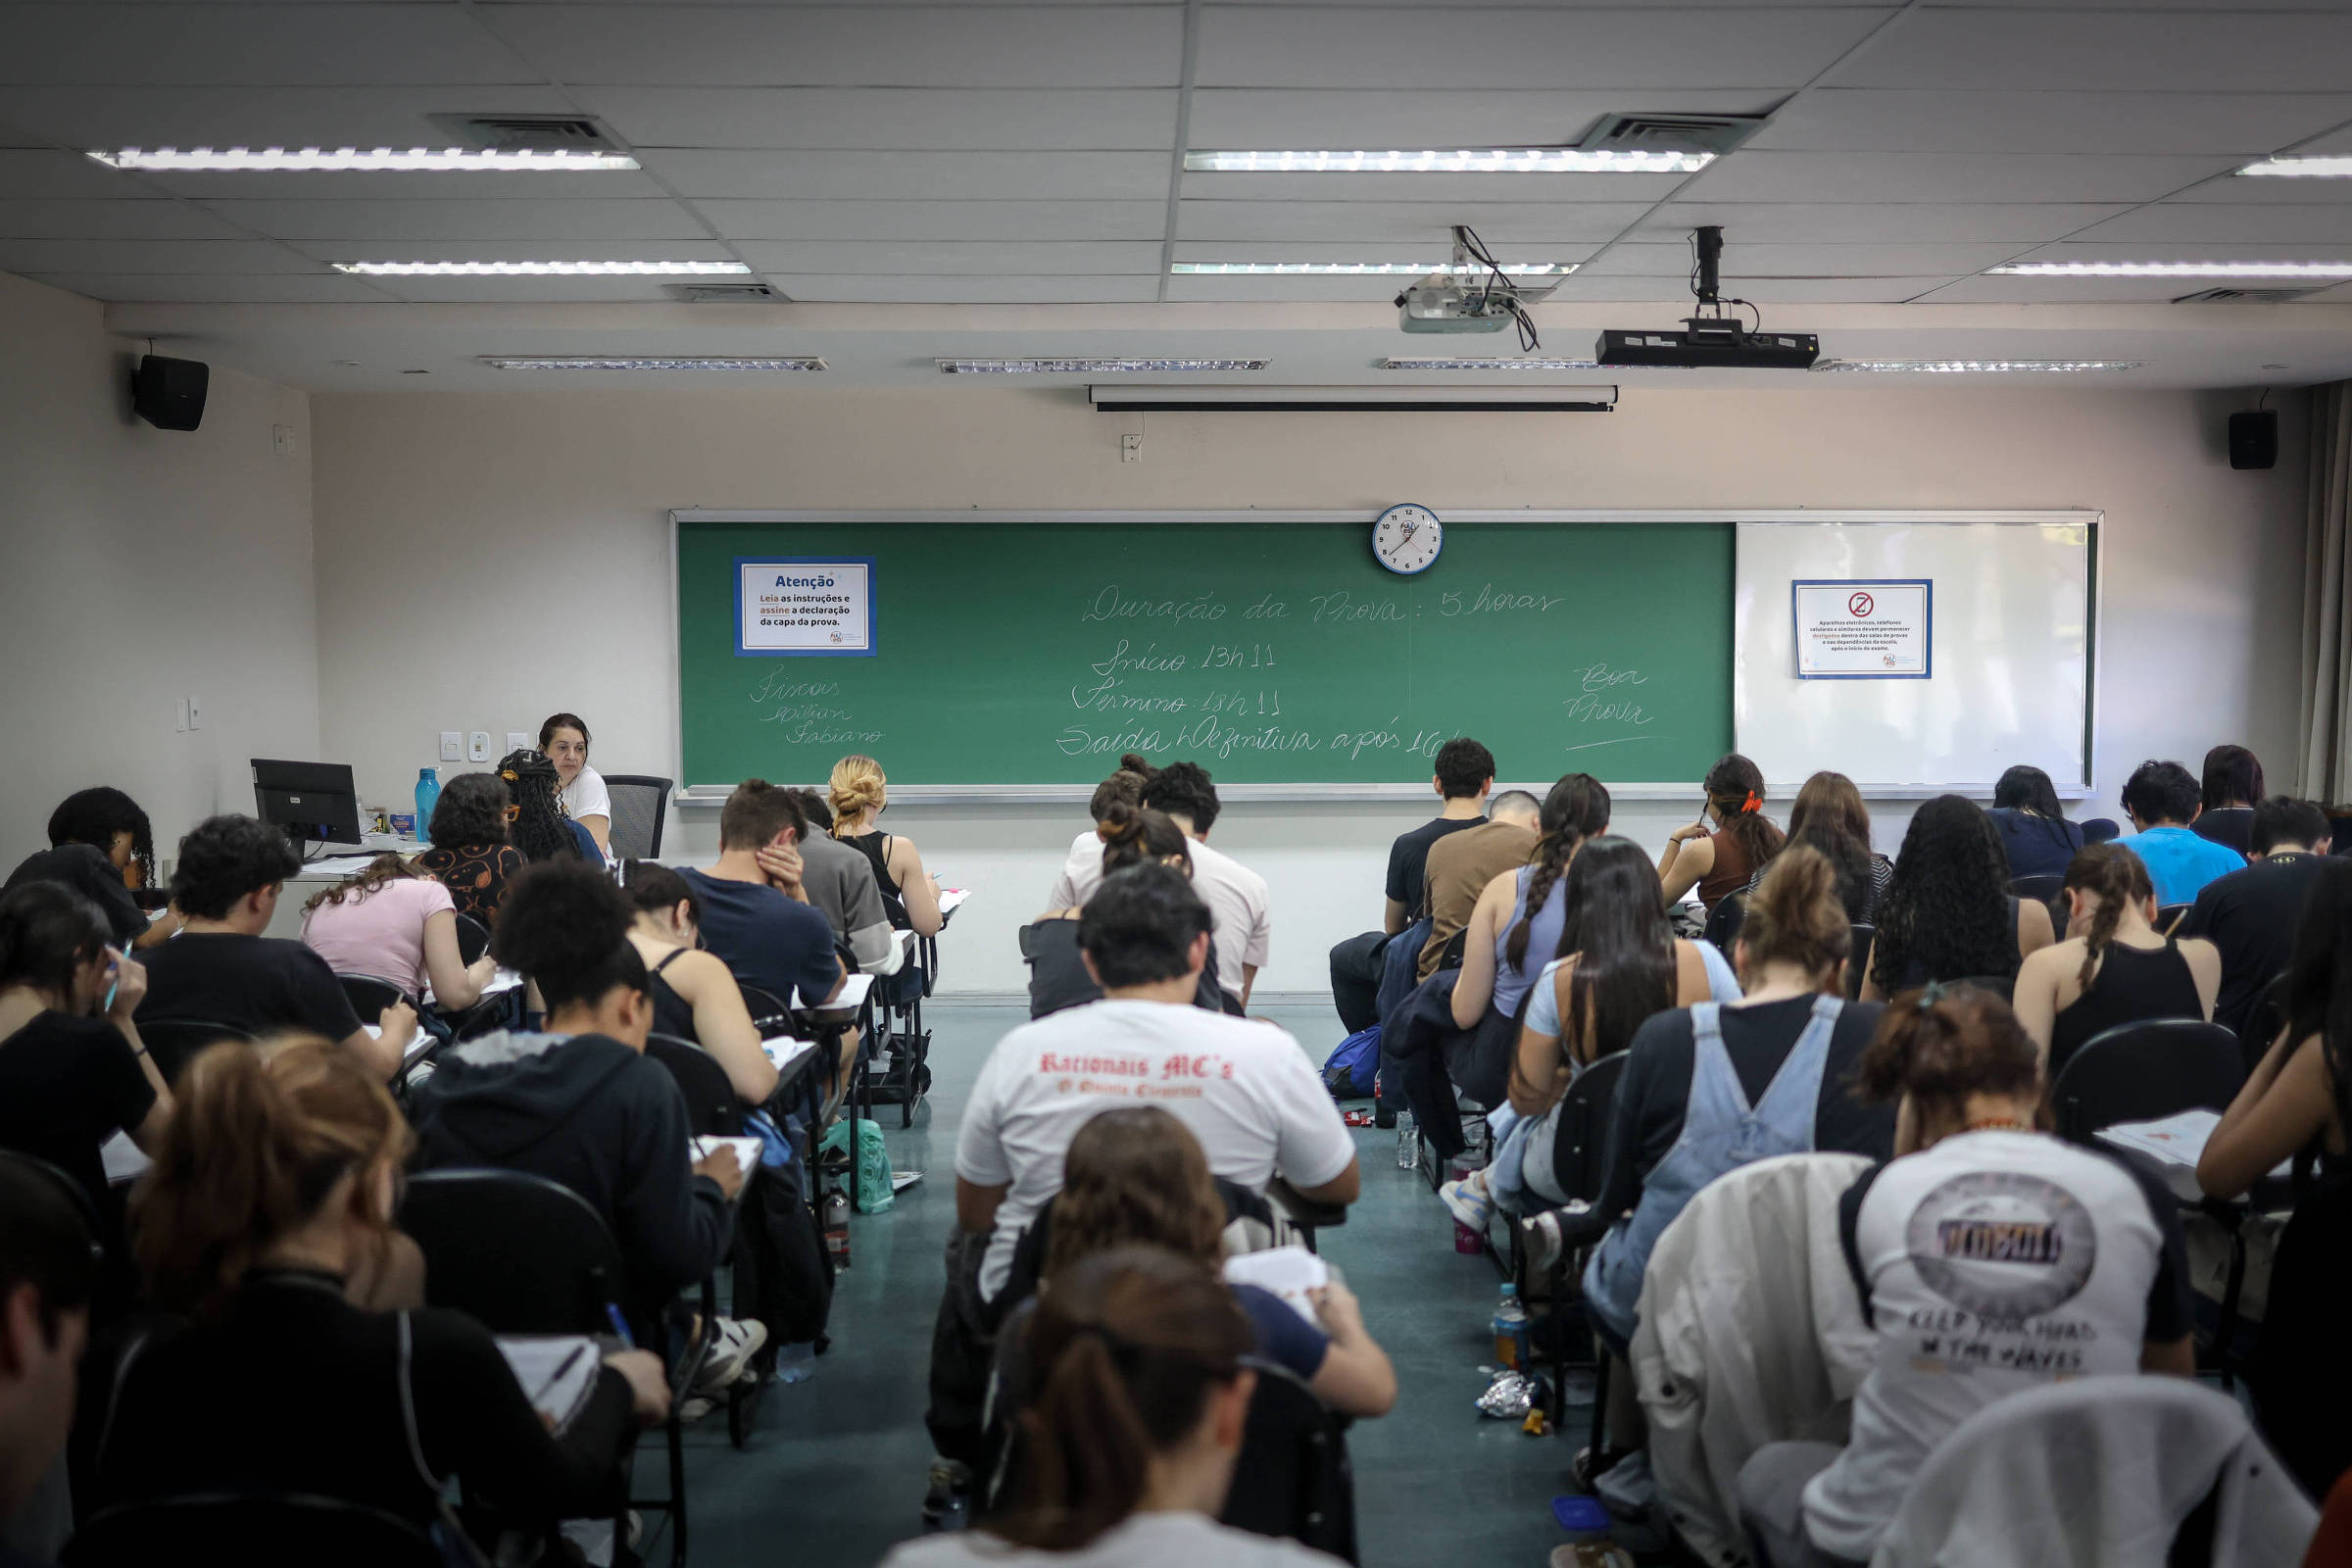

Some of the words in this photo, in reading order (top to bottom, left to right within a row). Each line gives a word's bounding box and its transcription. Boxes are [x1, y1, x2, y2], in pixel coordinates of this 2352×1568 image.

[775, 574, 835, 590] Atenção
[760, 594, 779, 603] Leia
[793, 594, 843, 605] instruções
[760, 606, 790, 614] assine
[799, 606, 851, 615] declaração
[1082, 585, 1227, 626] Duração
[1242, 593, 1298, 619] da
[1440, 591, 1464, 616] 5
[1465, 582, 1568, 613] horas
[760, 617, 772, 626] da
[773, 618, 796, 627] capa
[797, 617, 809, 626] da
[810, 618, 840, 627] prova.
[1573, 663, 1648, 692] Boa
[1562, 693, 1655, 725] Prova
[785, 720, 886, 745] Fabiano
[1055, 717, 1172, 756] Saída
[1331, 715, 1400, 760] após
